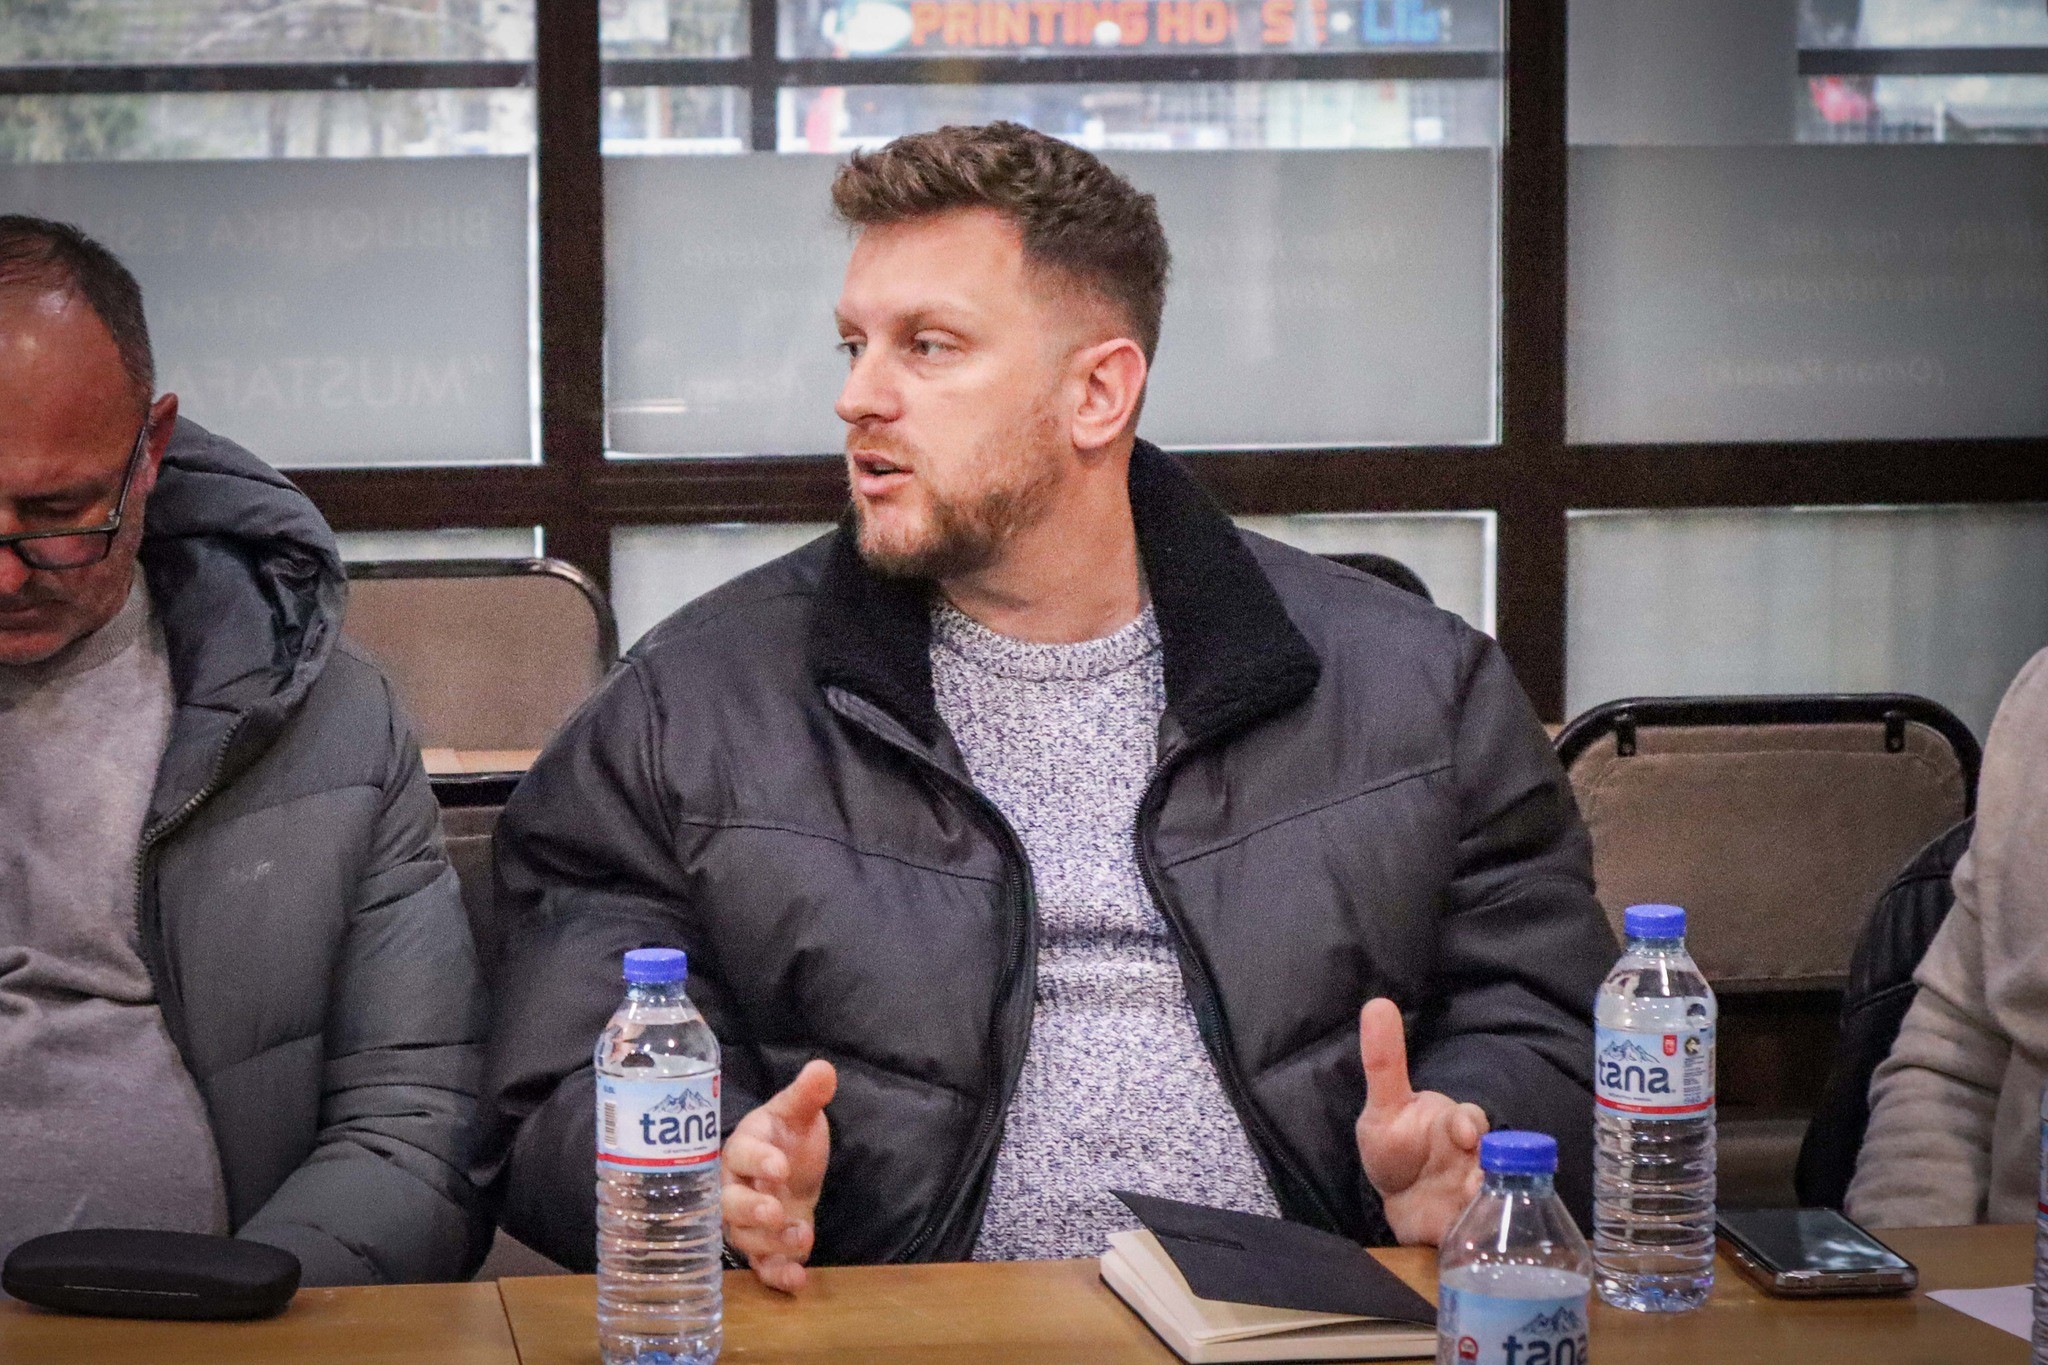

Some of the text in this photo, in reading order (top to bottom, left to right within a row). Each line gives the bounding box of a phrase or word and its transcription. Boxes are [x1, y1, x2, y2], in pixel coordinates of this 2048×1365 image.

[910, 0, 1148, 46] PRINTING
[1597, 1053, 1671, 1095] tana
[638, 1110, 718, 1146] tana
